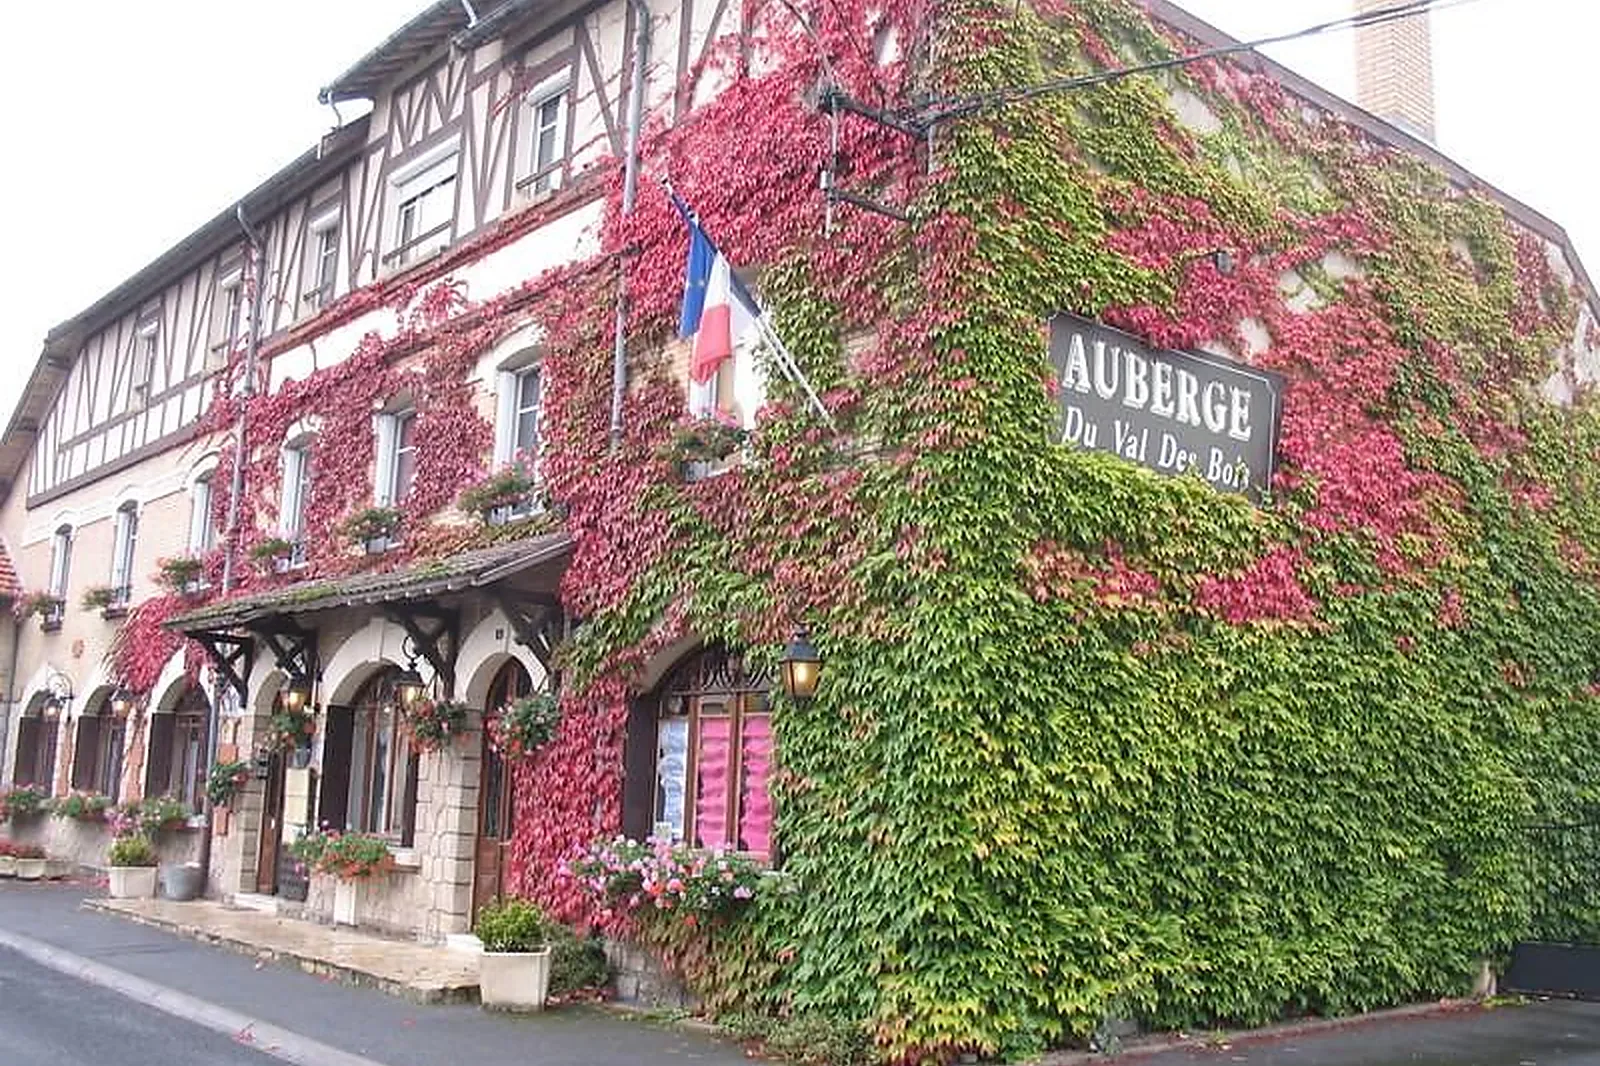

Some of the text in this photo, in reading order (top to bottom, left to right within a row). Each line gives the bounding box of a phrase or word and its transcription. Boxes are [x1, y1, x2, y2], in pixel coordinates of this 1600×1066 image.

[1062, 332, 1252, 442] AUBERGE
[1062, 406, 1098, 449] Du
[1115, 420, 1148, 461] Val
